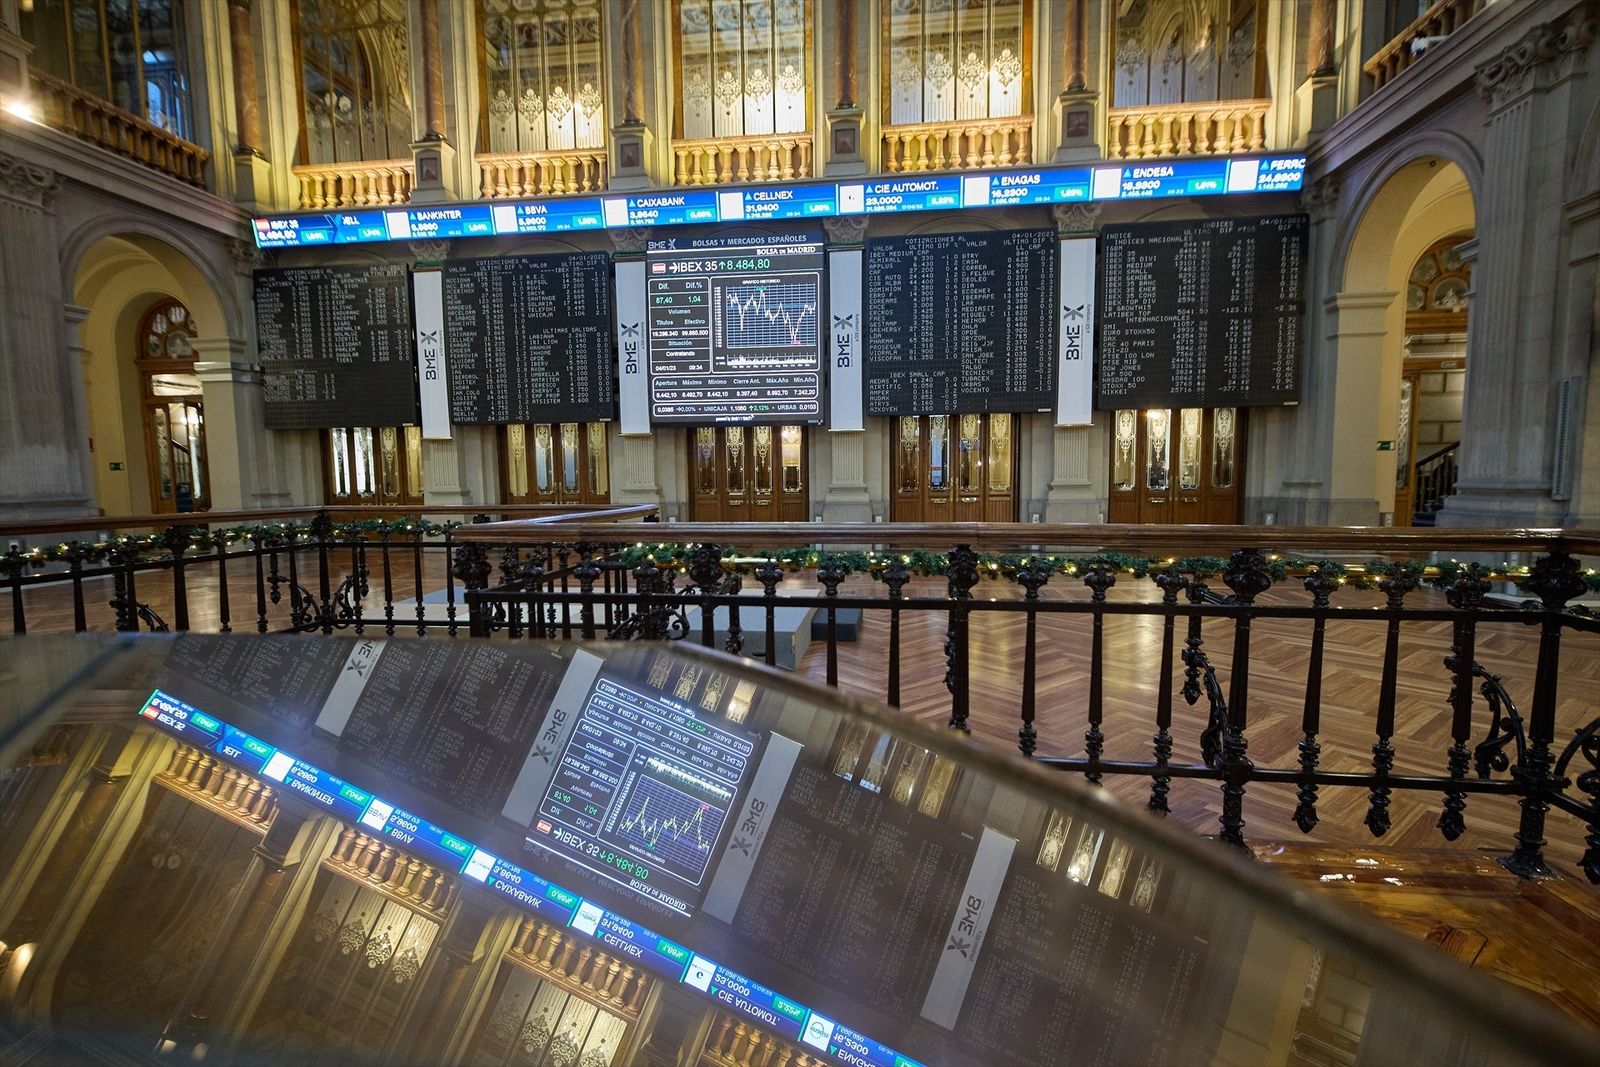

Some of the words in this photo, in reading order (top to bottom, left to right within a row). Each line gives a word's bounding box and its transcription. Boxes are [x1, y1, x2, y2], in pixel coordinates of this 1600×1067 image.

[1133, 166, 1173, 178] ENDESA
[1001, 175, 1040, 186] ENAGAS
[875, 184, 890, 193] CIE
[892, 181, 939, 192] AUTOMOT.
[754, 191, 793, 200] CELLNEX
[866, 196, 902, 205] 23,0000
[637, 197, 685, 207] CAIXABANK
[525, 206, 547, 214] BBVA
[746, 204, 779, 212] 31,9400
[417, 210, 461, 220] BANKINTER
[648, 241, 666, 249] BME
[727, 237, 765, 245] MERCADOS
[768, 235, 807, 243] ESPAÑOLES
[905, 236, 954, 244] COTIZACIONES
[1149, 236, 1192, 244] NACIONALES
[677, 262, 702, 273] IBEX
[705, 261, 717, 270] 35
[727, 259, 770, 270] 8.484,80
[1066, 326, 1080, 360] BME
[837, 334, 849, 367] BME
[625, 342, 637, 373] BME
[424, 348, 436, 380] BME
